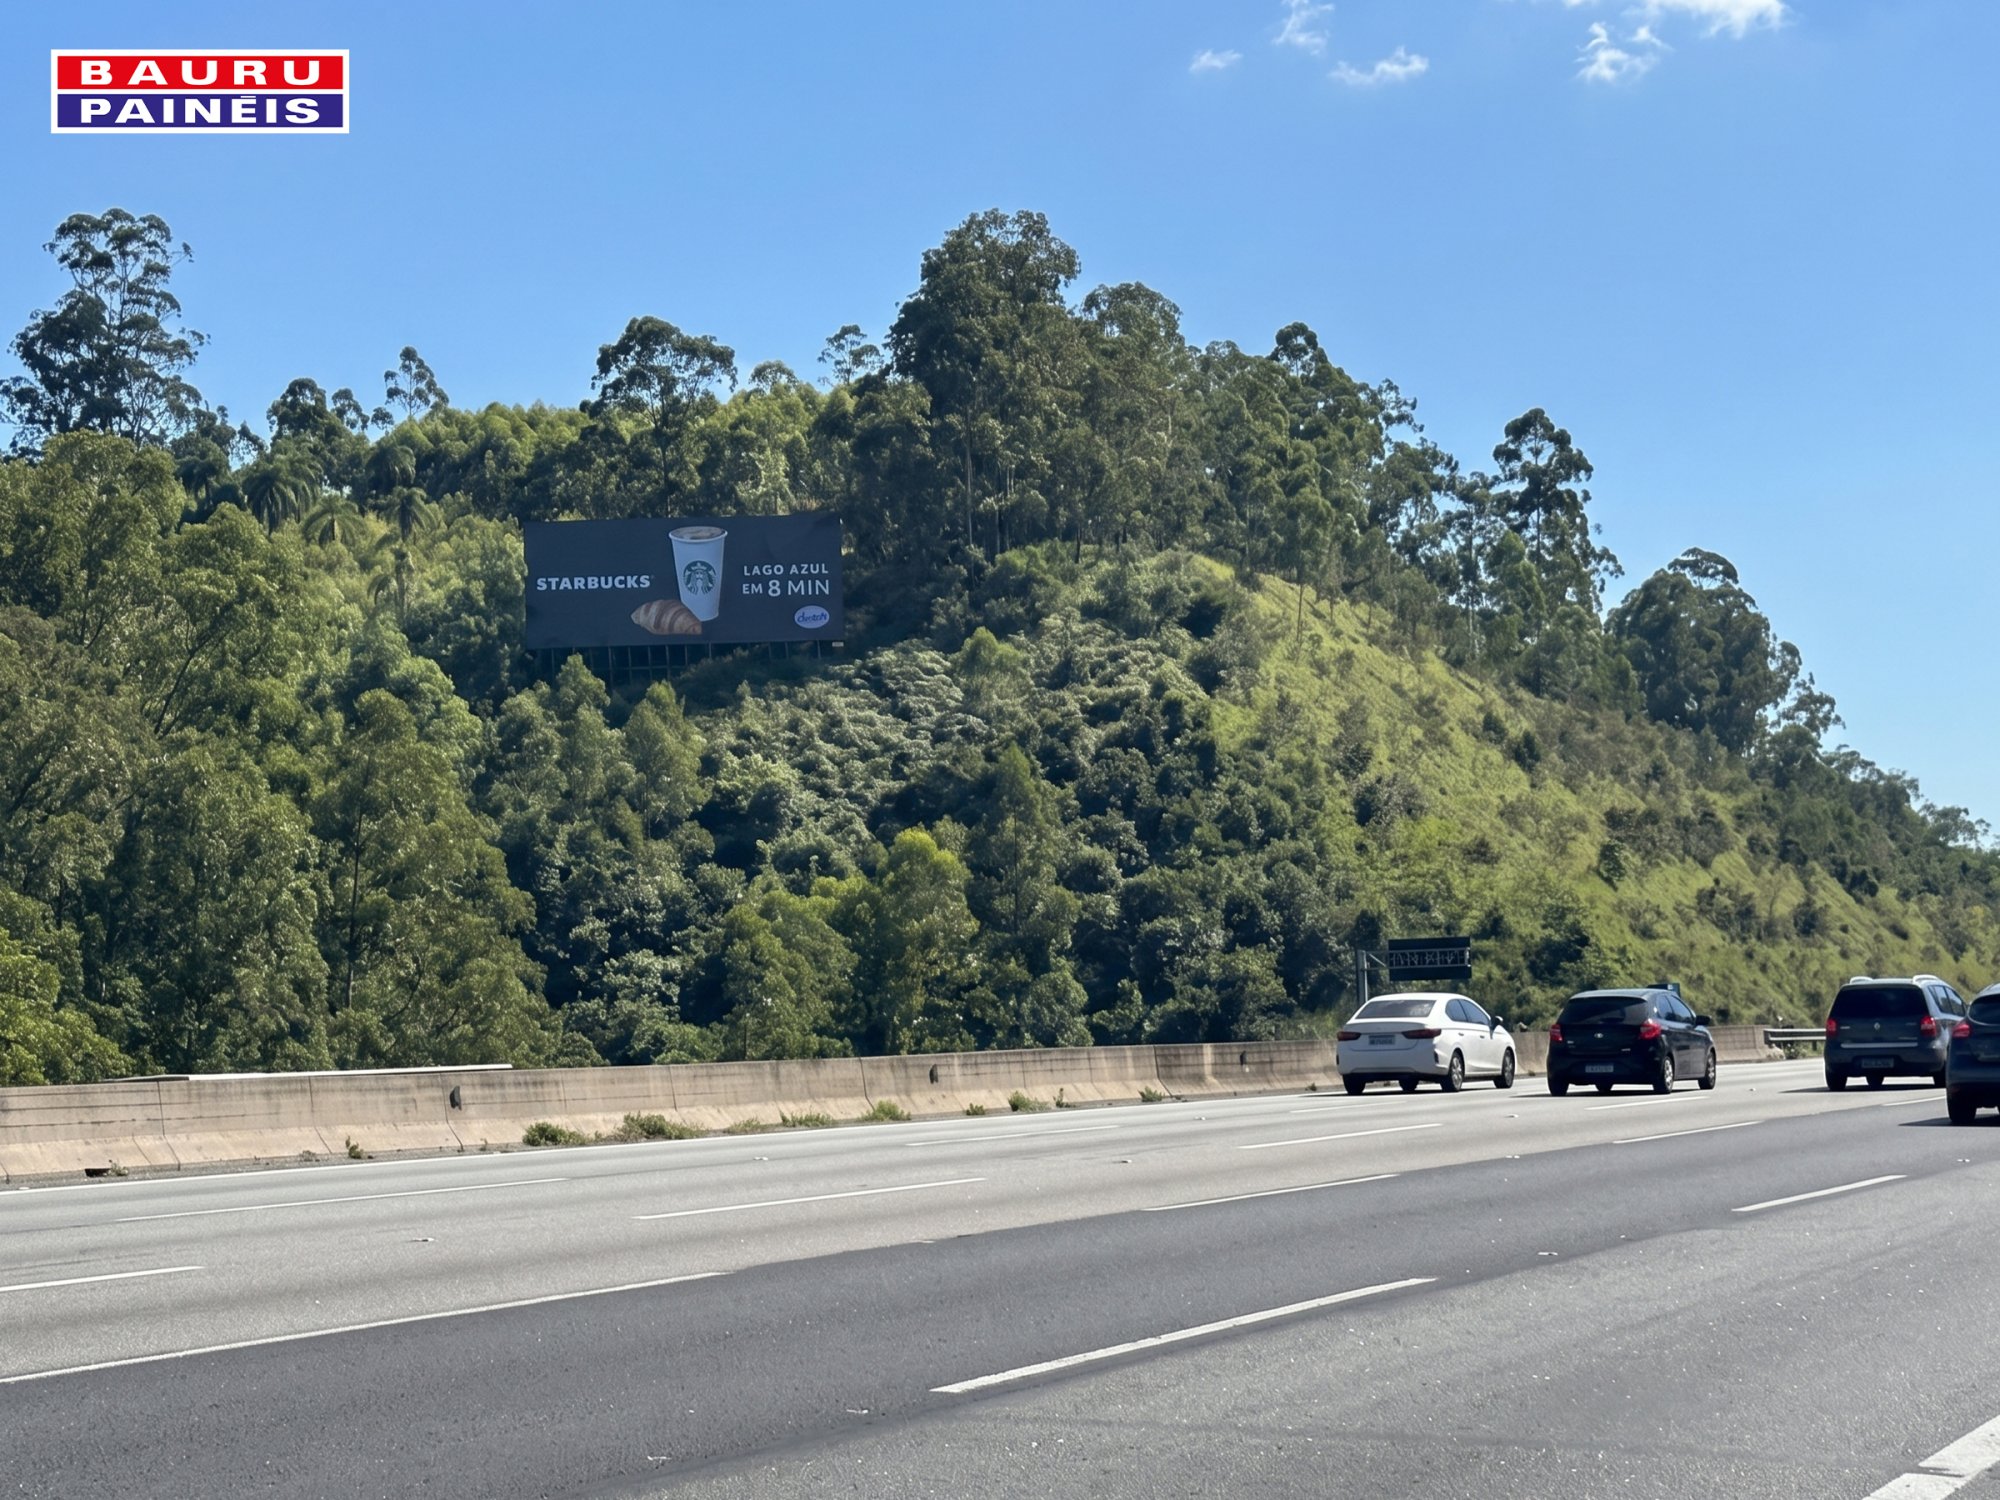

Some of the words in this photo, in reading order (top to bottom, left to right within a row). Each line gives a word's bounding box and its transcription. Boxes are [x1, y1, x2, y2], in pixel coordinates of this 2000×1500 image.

[743, 564, 784, 576] LAGO
[789, 563, 829, 575] AZUL
[536, 574, 651, 591] STARBUCKS
[742, 583, 763, 595] EM
[768, 579, 781, 597] 8
[787, 579, 830, 596] MIN
